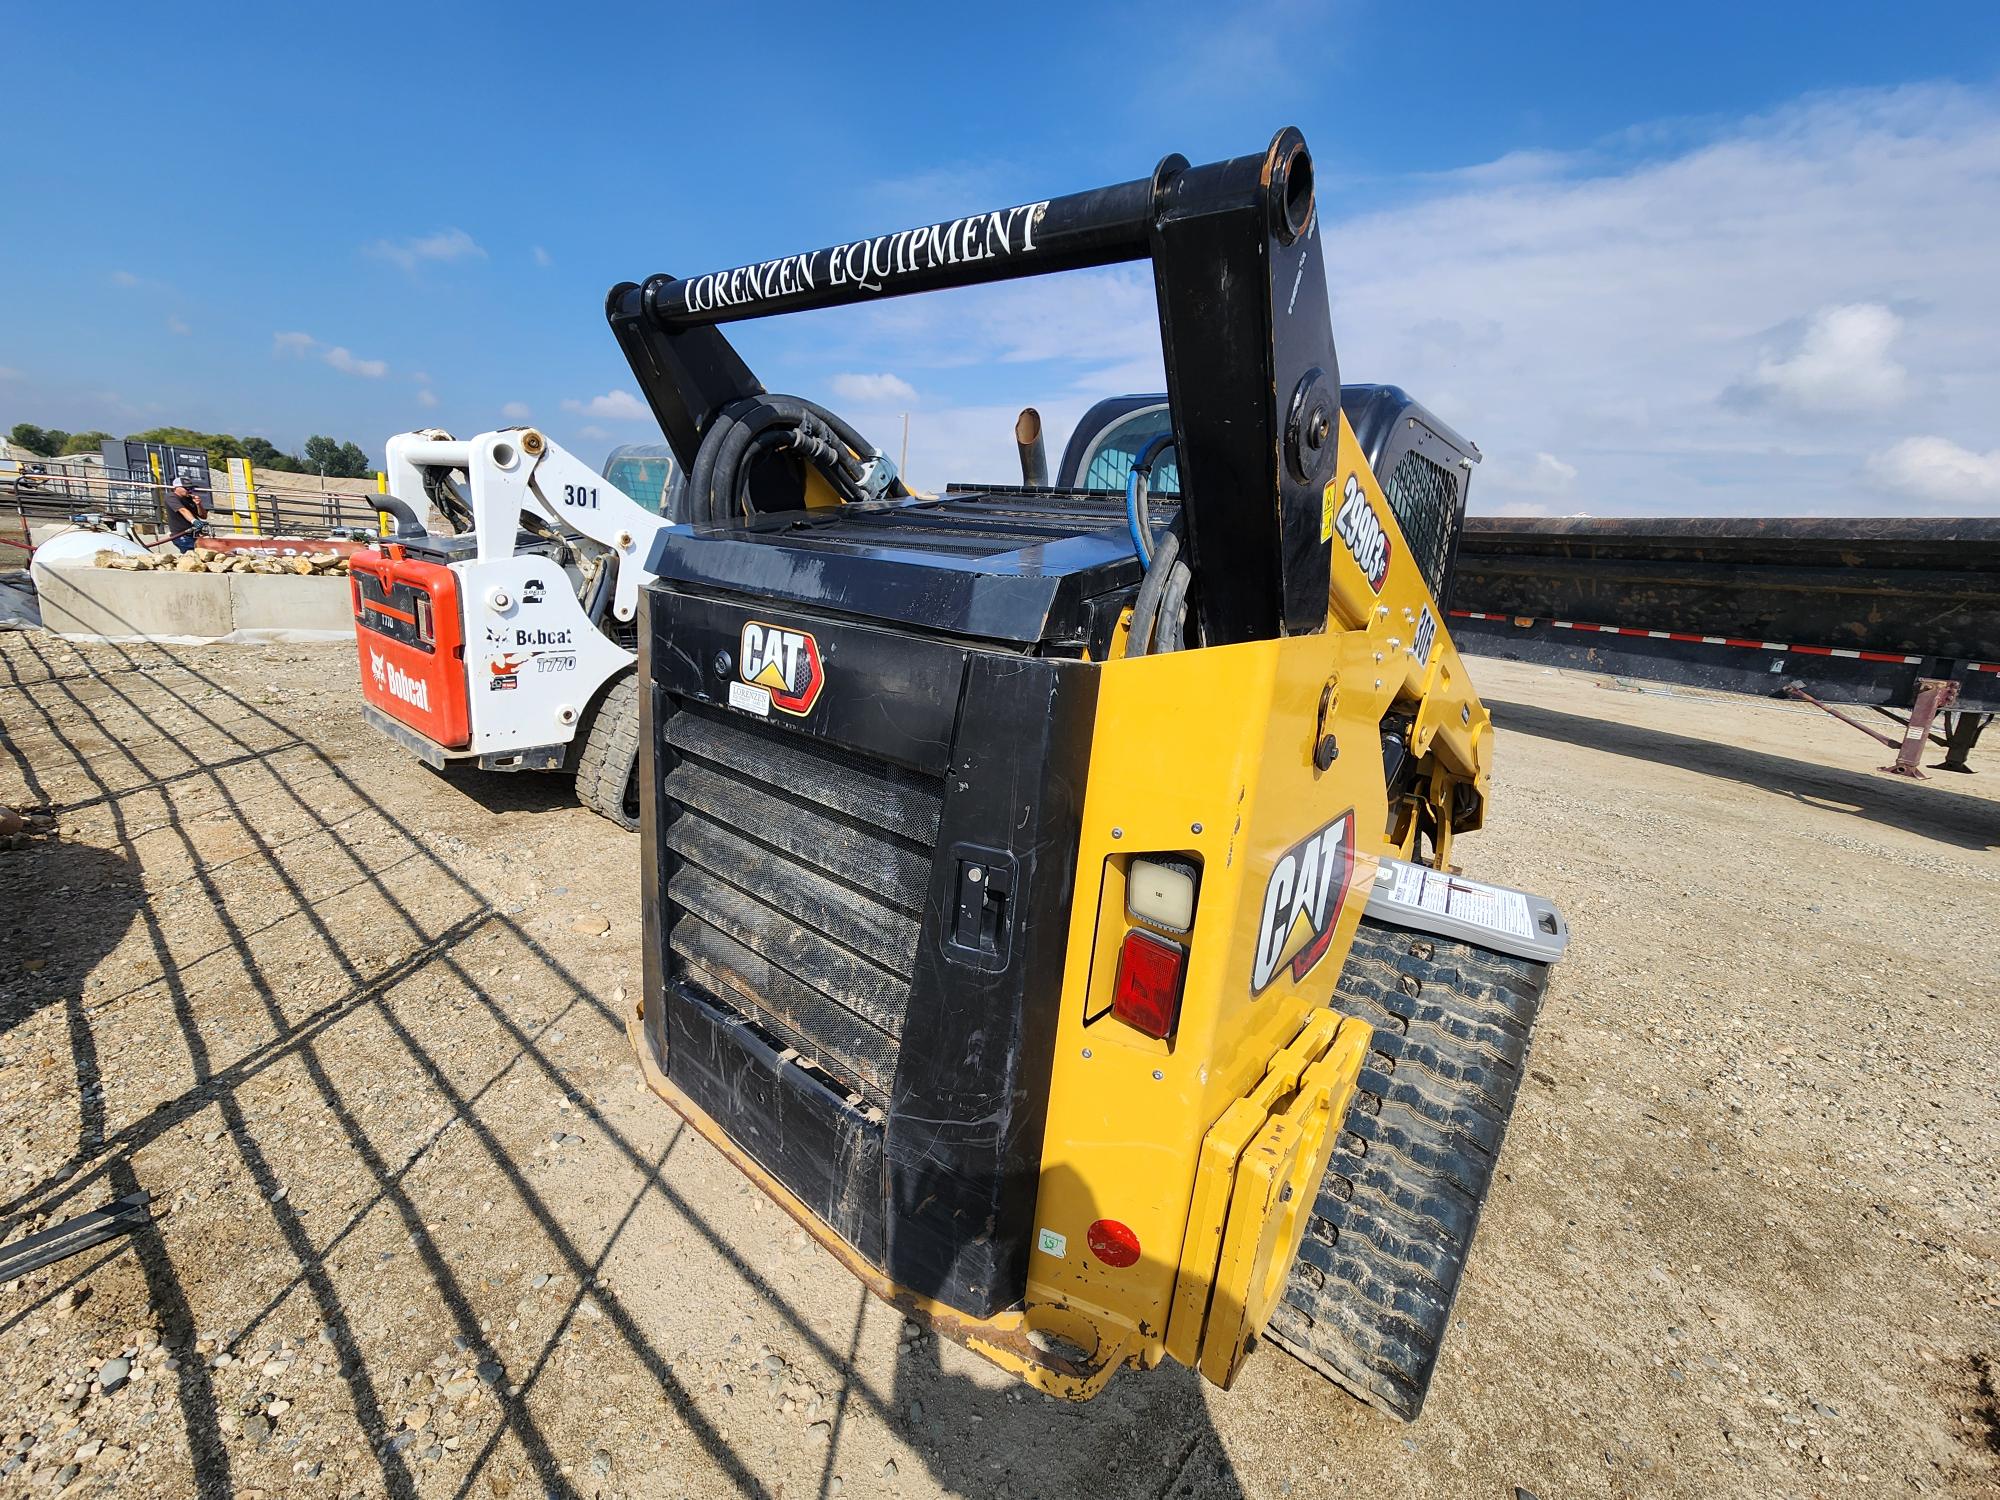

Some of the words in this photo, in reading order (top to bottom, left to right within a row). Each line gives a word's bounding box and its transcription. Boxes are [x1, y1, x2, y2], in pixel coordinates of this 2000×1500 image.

[685, 251, 820, 313] LORENZEN
[829, 200, 1050, 292] EQUIPMENT
[564, 485, 597, 509] 301
[1336, 476, 1385, 582] 299D3
[516, 629, 572, 646] Bobcat
[536, 656, 577, 673] T770
[742, 624, 804, 692] CAT
[1413, 606, 1436, 667] 306
[386, 661, 431, 712] Bobcat
[1254, 817, 1346, 990] CAT
